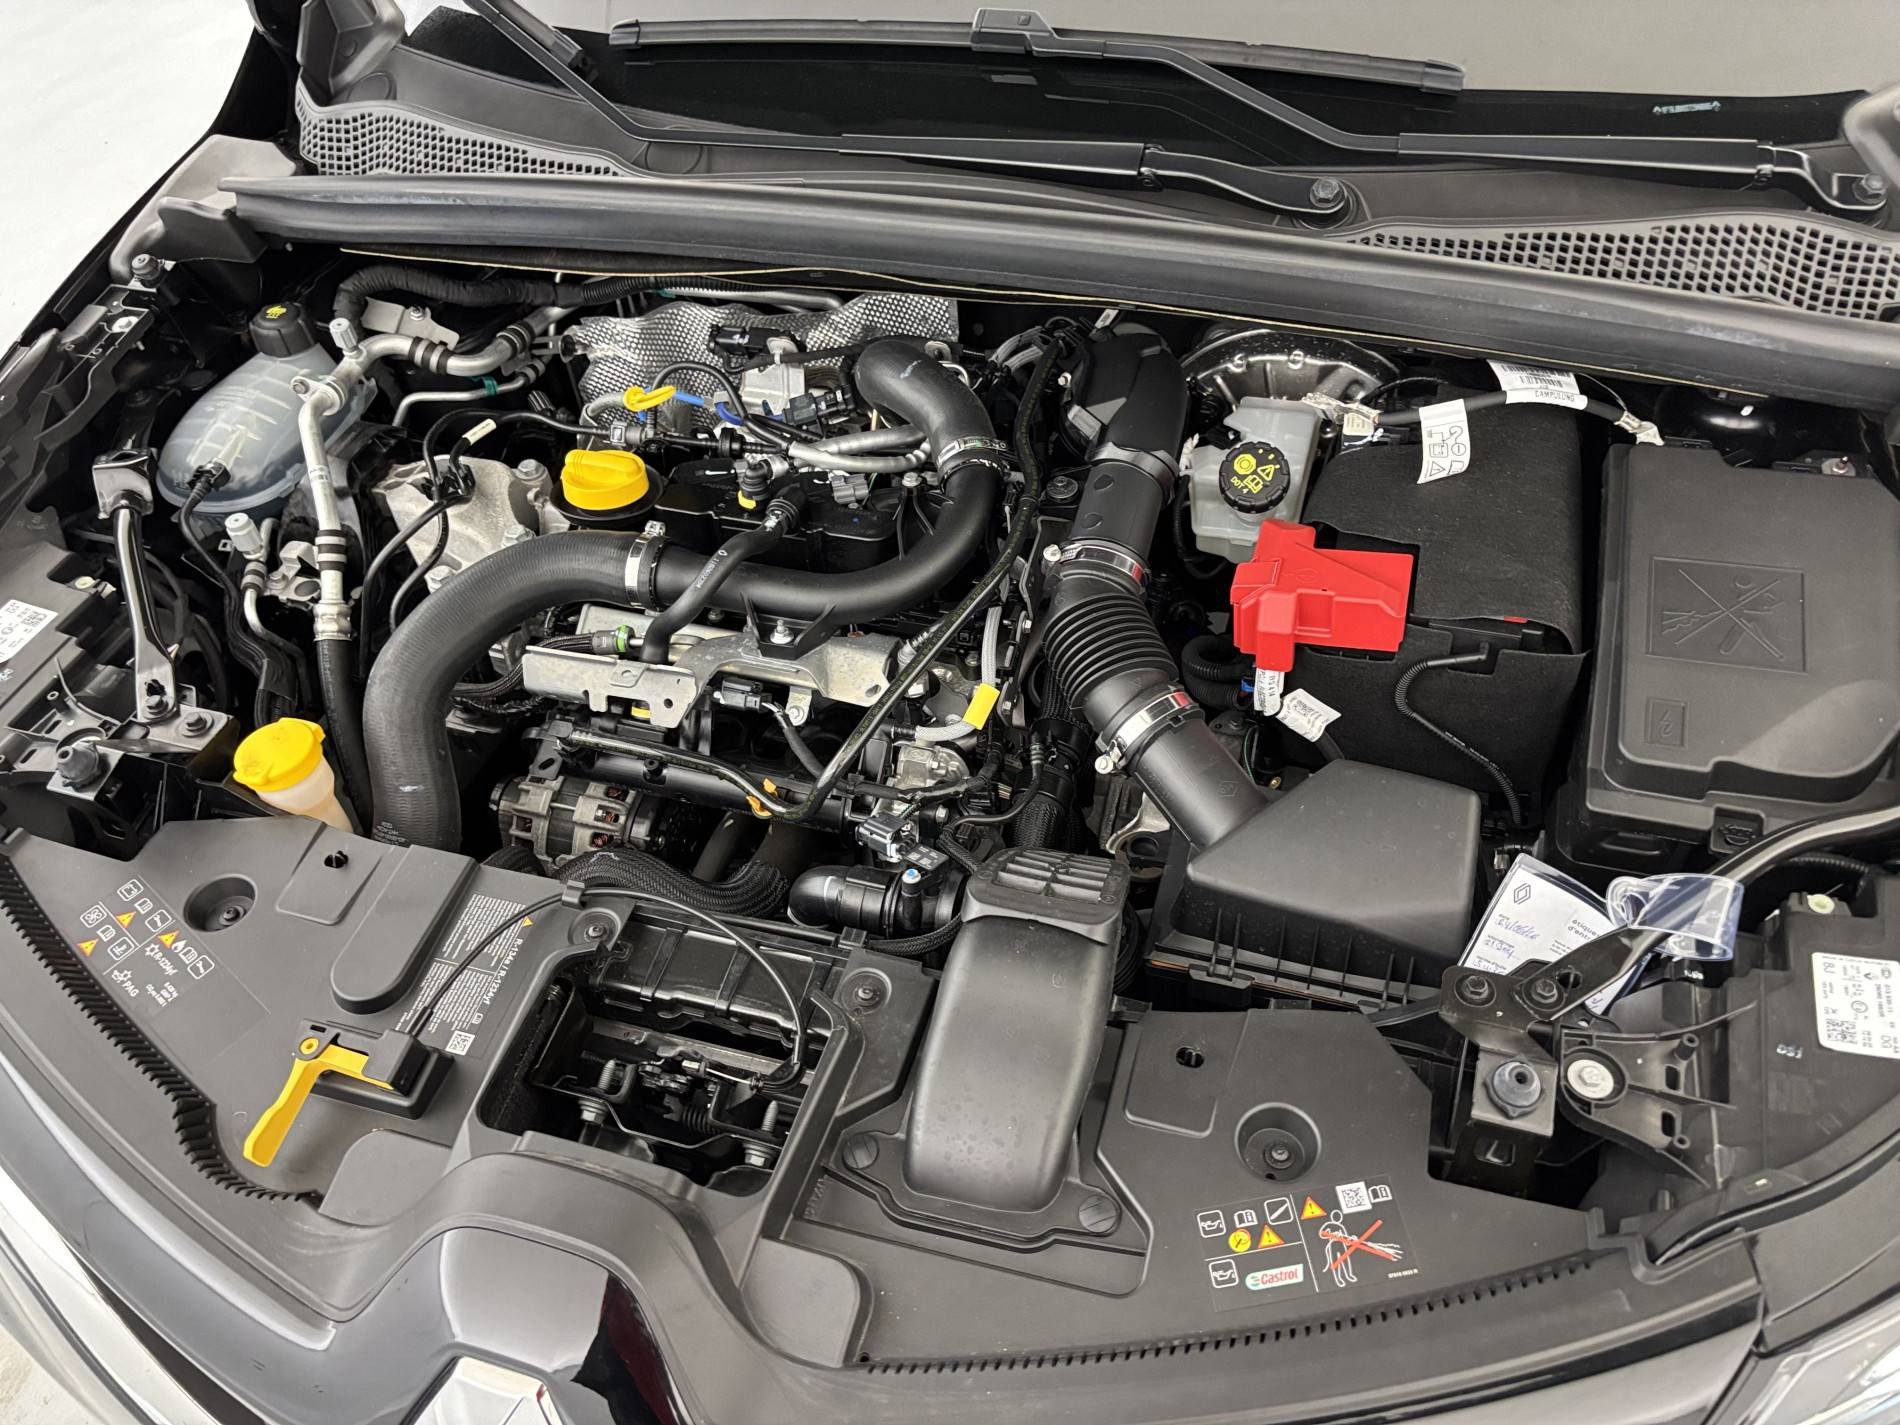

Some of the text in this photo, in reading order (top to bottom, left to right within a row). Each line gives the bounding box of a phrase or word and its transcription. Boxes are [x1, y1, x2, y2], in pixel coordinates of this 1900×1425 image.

[1231, 476, 1244, 489] DOT
[504, 938, 524, 965] R-134a
[122, 980, 140, 997] PAG
[483, 969, 507, 1005] R-1234yf
[1261, 1268, 1300, 1285] Castrol
